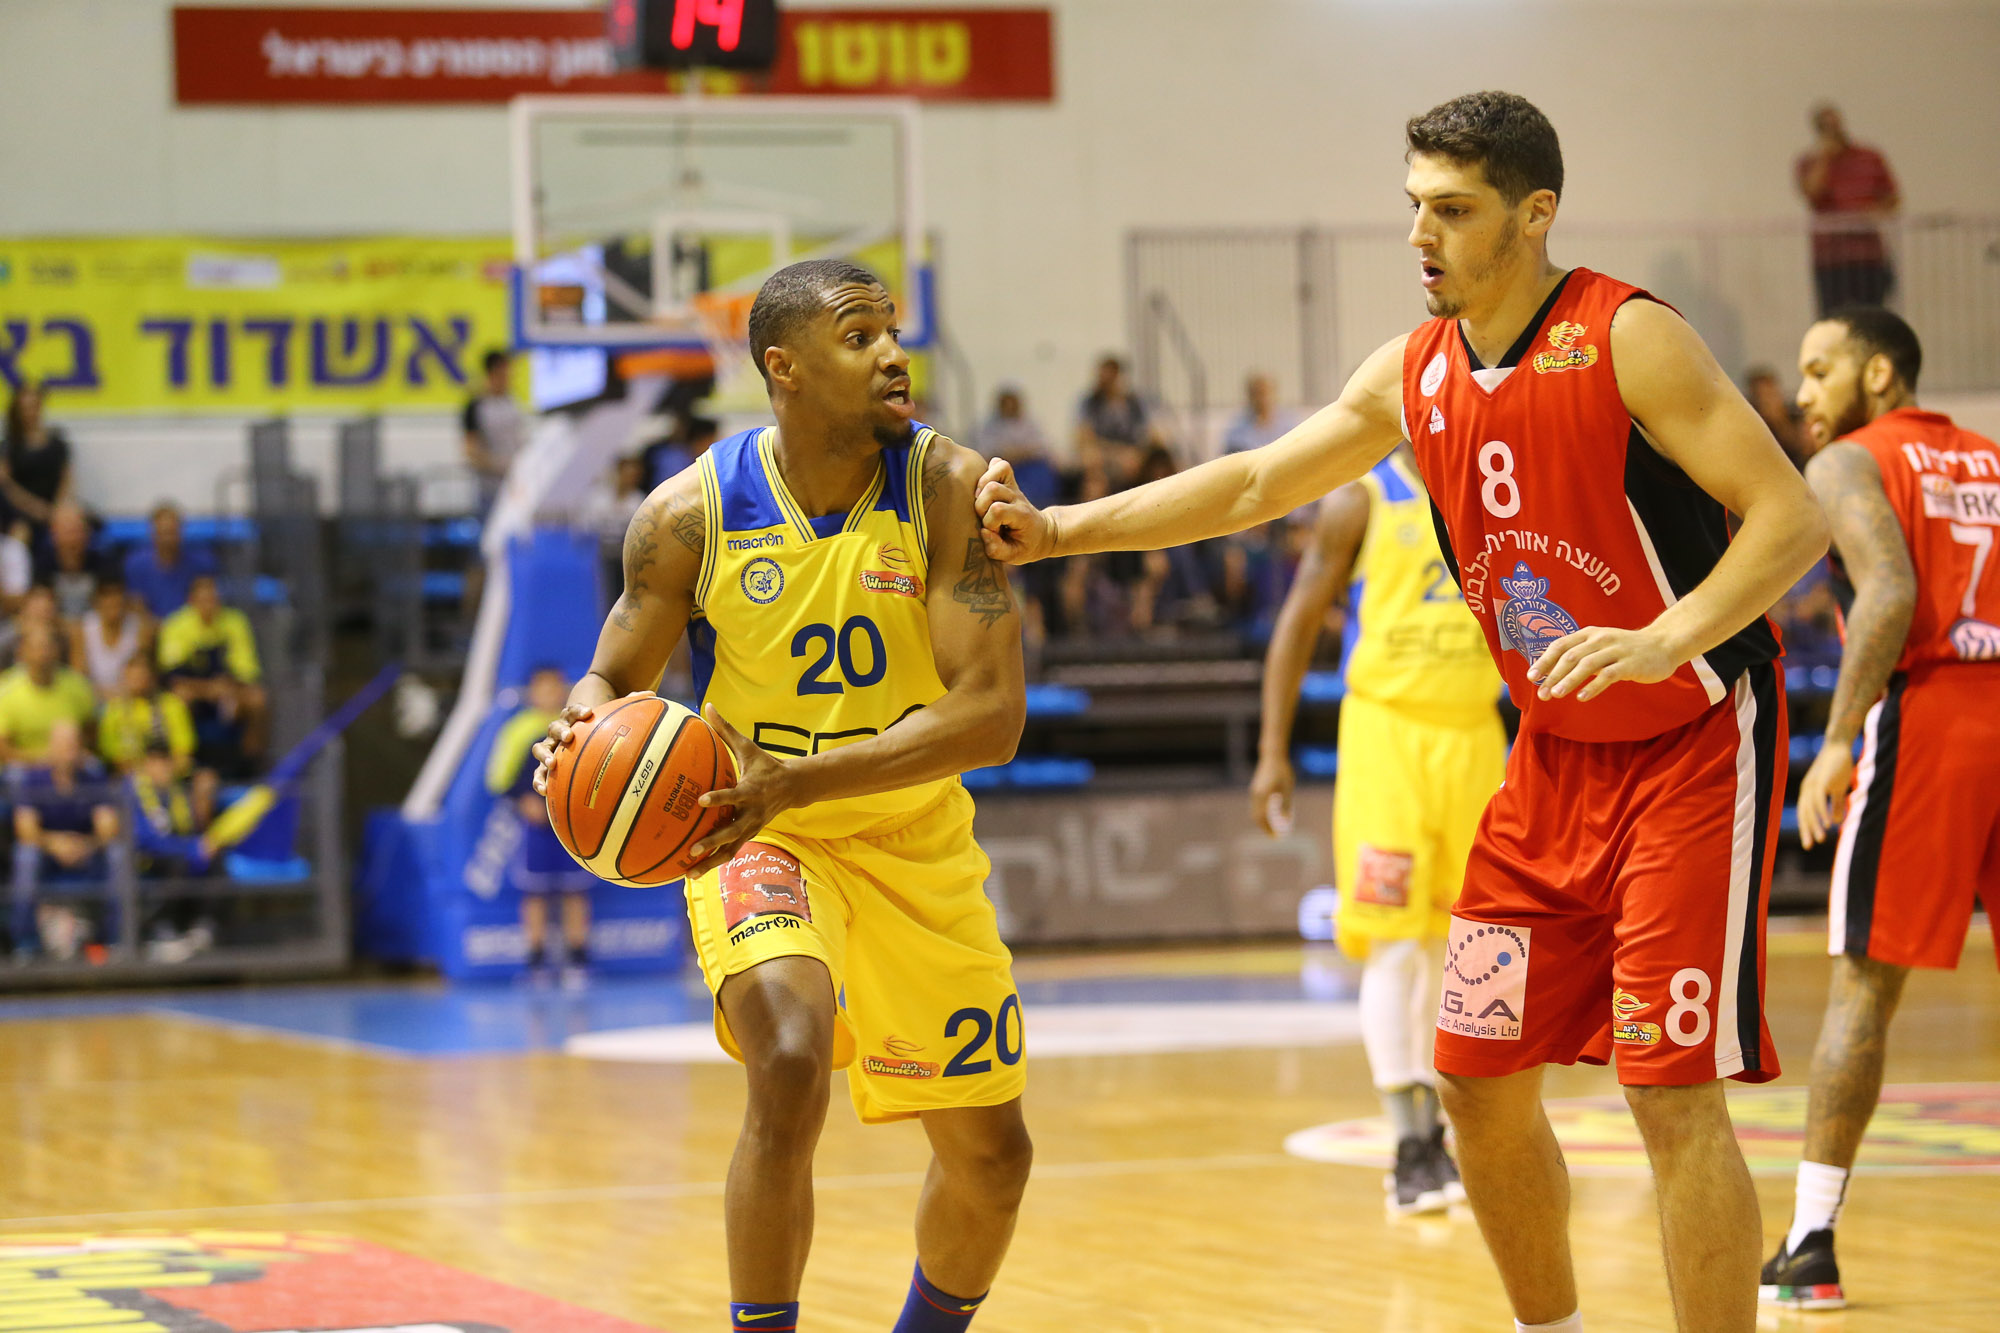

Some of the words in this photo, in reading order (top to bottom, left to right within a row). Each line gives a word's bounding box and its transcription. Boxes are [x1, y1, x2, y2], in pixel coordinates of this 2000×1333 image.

[795, 20, 971, 87] טוטו
[139, 317, 470, 389] אשדוד
[1477, 440, 1521, 519] 8
[727, 532, 784, 550] macron
[1485, 530, 1549, 554] אזורית
[866, 574, 911, 593] Winner
[1556, 540, 1621, 596] מועצה
[1950, 522, 1994, 617] 7
[1514, 600, 1547, 613] אזורית
[1552, 610, 1576, 634] ועצה
[790, 614, 887, 697] 20
[632, 759, 654, 797] GG7X
[662, 773, 686, 813] APPROVED
[671, 777, 703, 822] FIBA
[730, 916, 800, 946] macron
[1665, 967, 1711, 1047] 8
[942, 993, 1023, 1077] 20
[1452, 1018, 1497, 1037] Analysis
[1501, 1025, 1520, 1037] Ltd
[869, 1060, 919, 1076] Winner
